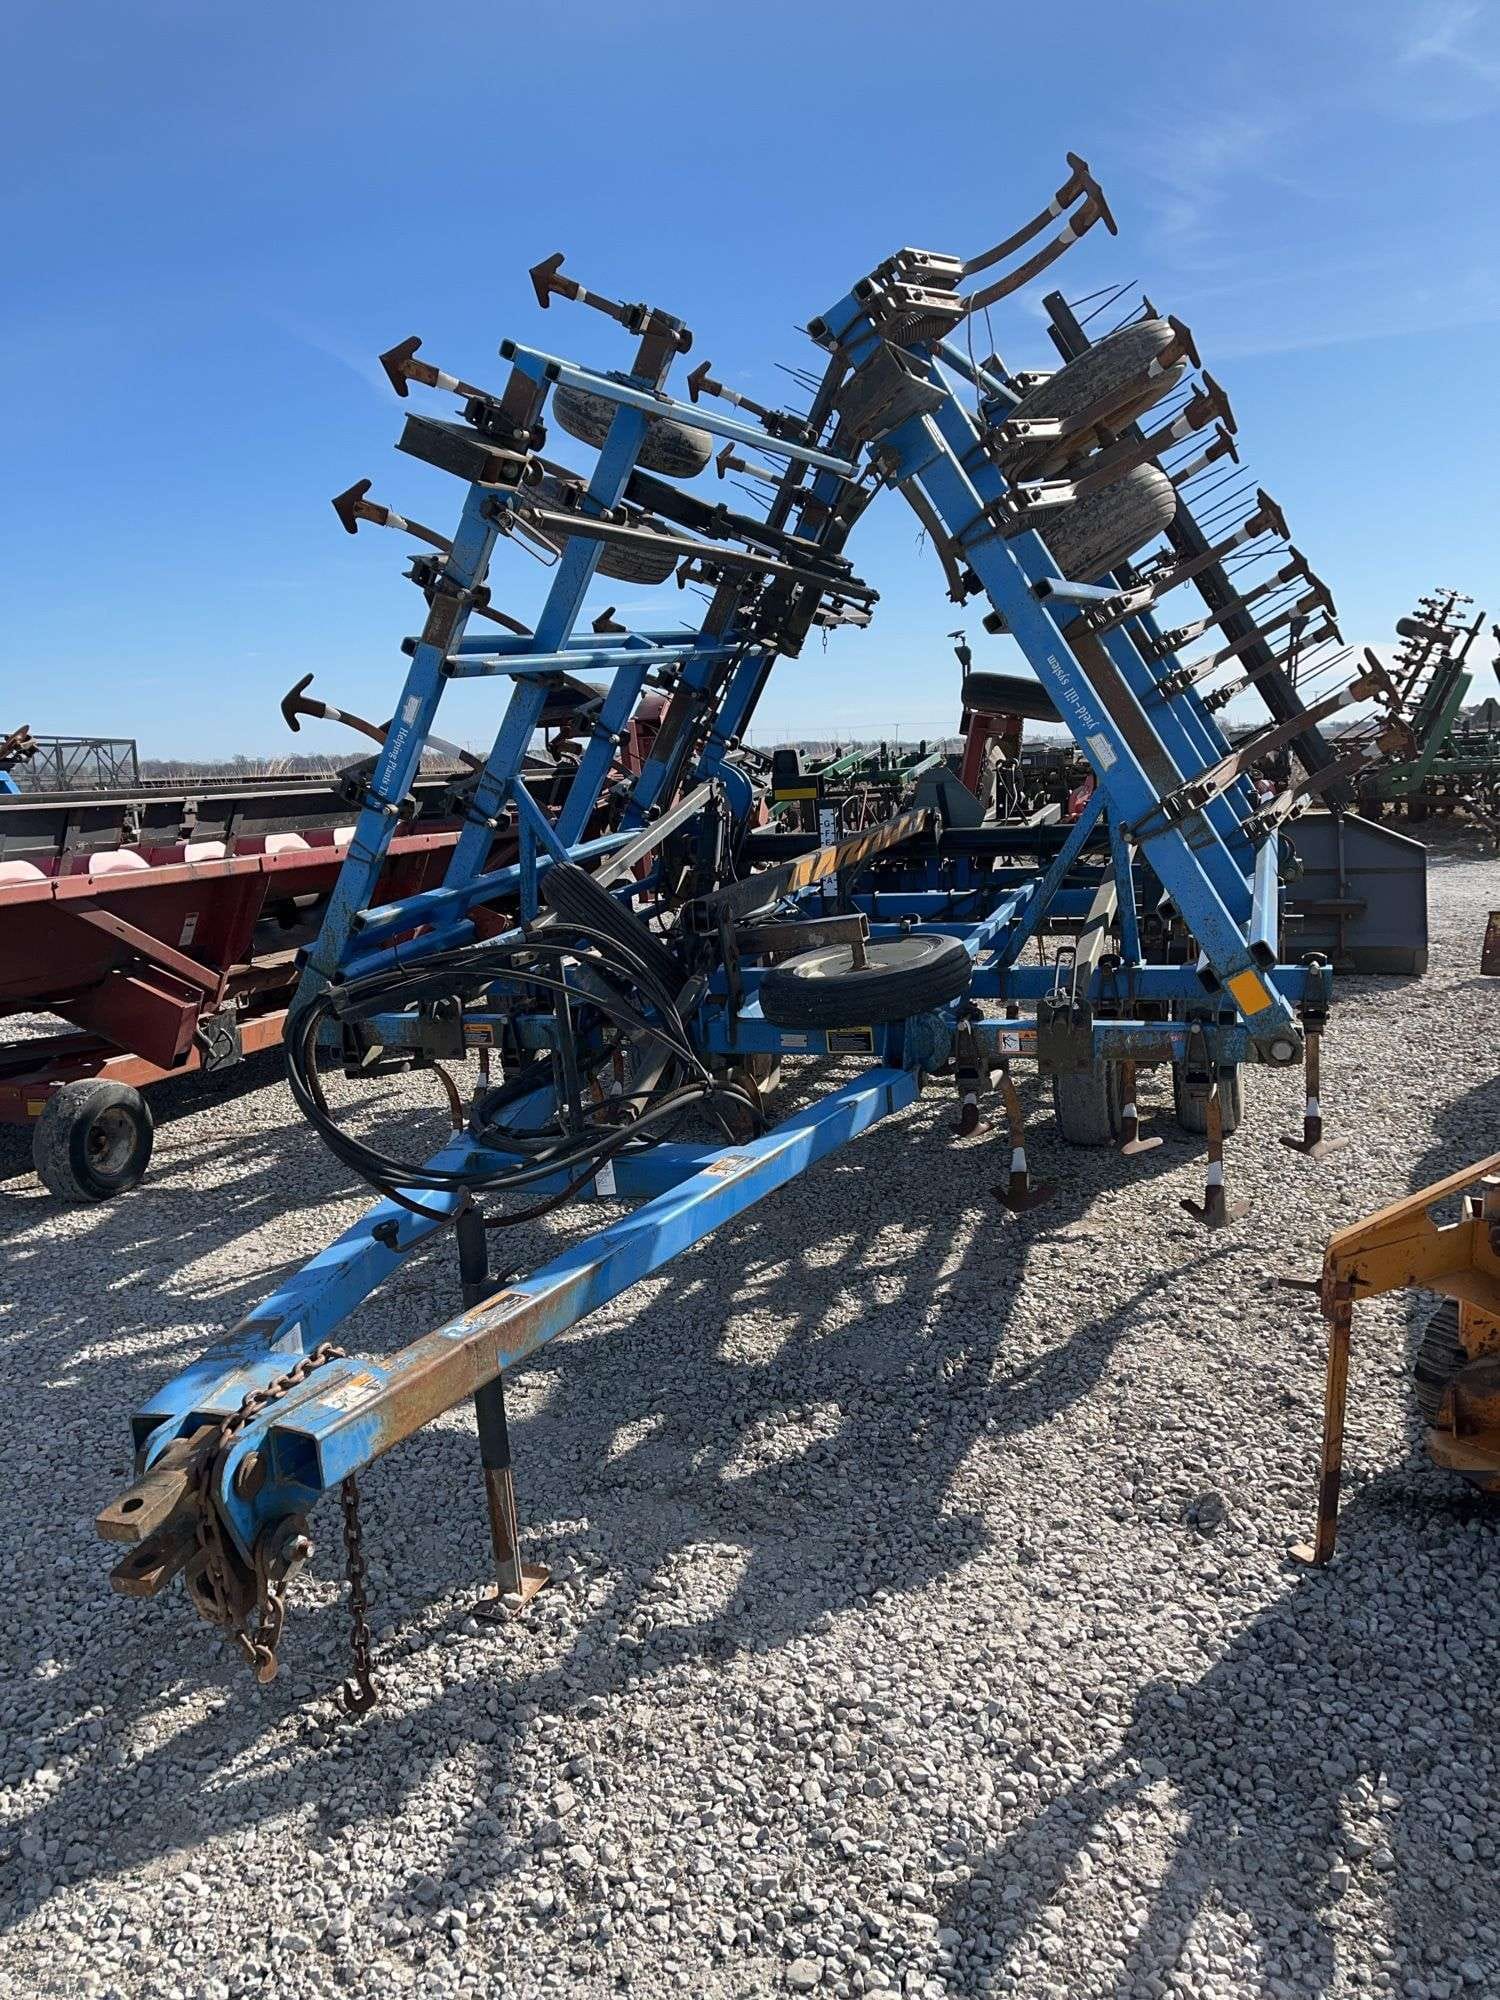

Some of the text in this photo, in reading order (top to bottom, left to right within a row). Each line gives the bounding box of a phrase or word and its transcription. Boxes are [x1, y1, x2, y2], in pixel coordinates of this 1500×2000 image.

[1047, 654, 1100, 730] yield-till system
[388, 727, 409, 760] Helping
[381, 760, 398, 784] Plants
[823, 820, 831, 828] G
[826, 876, 833, 884] A
